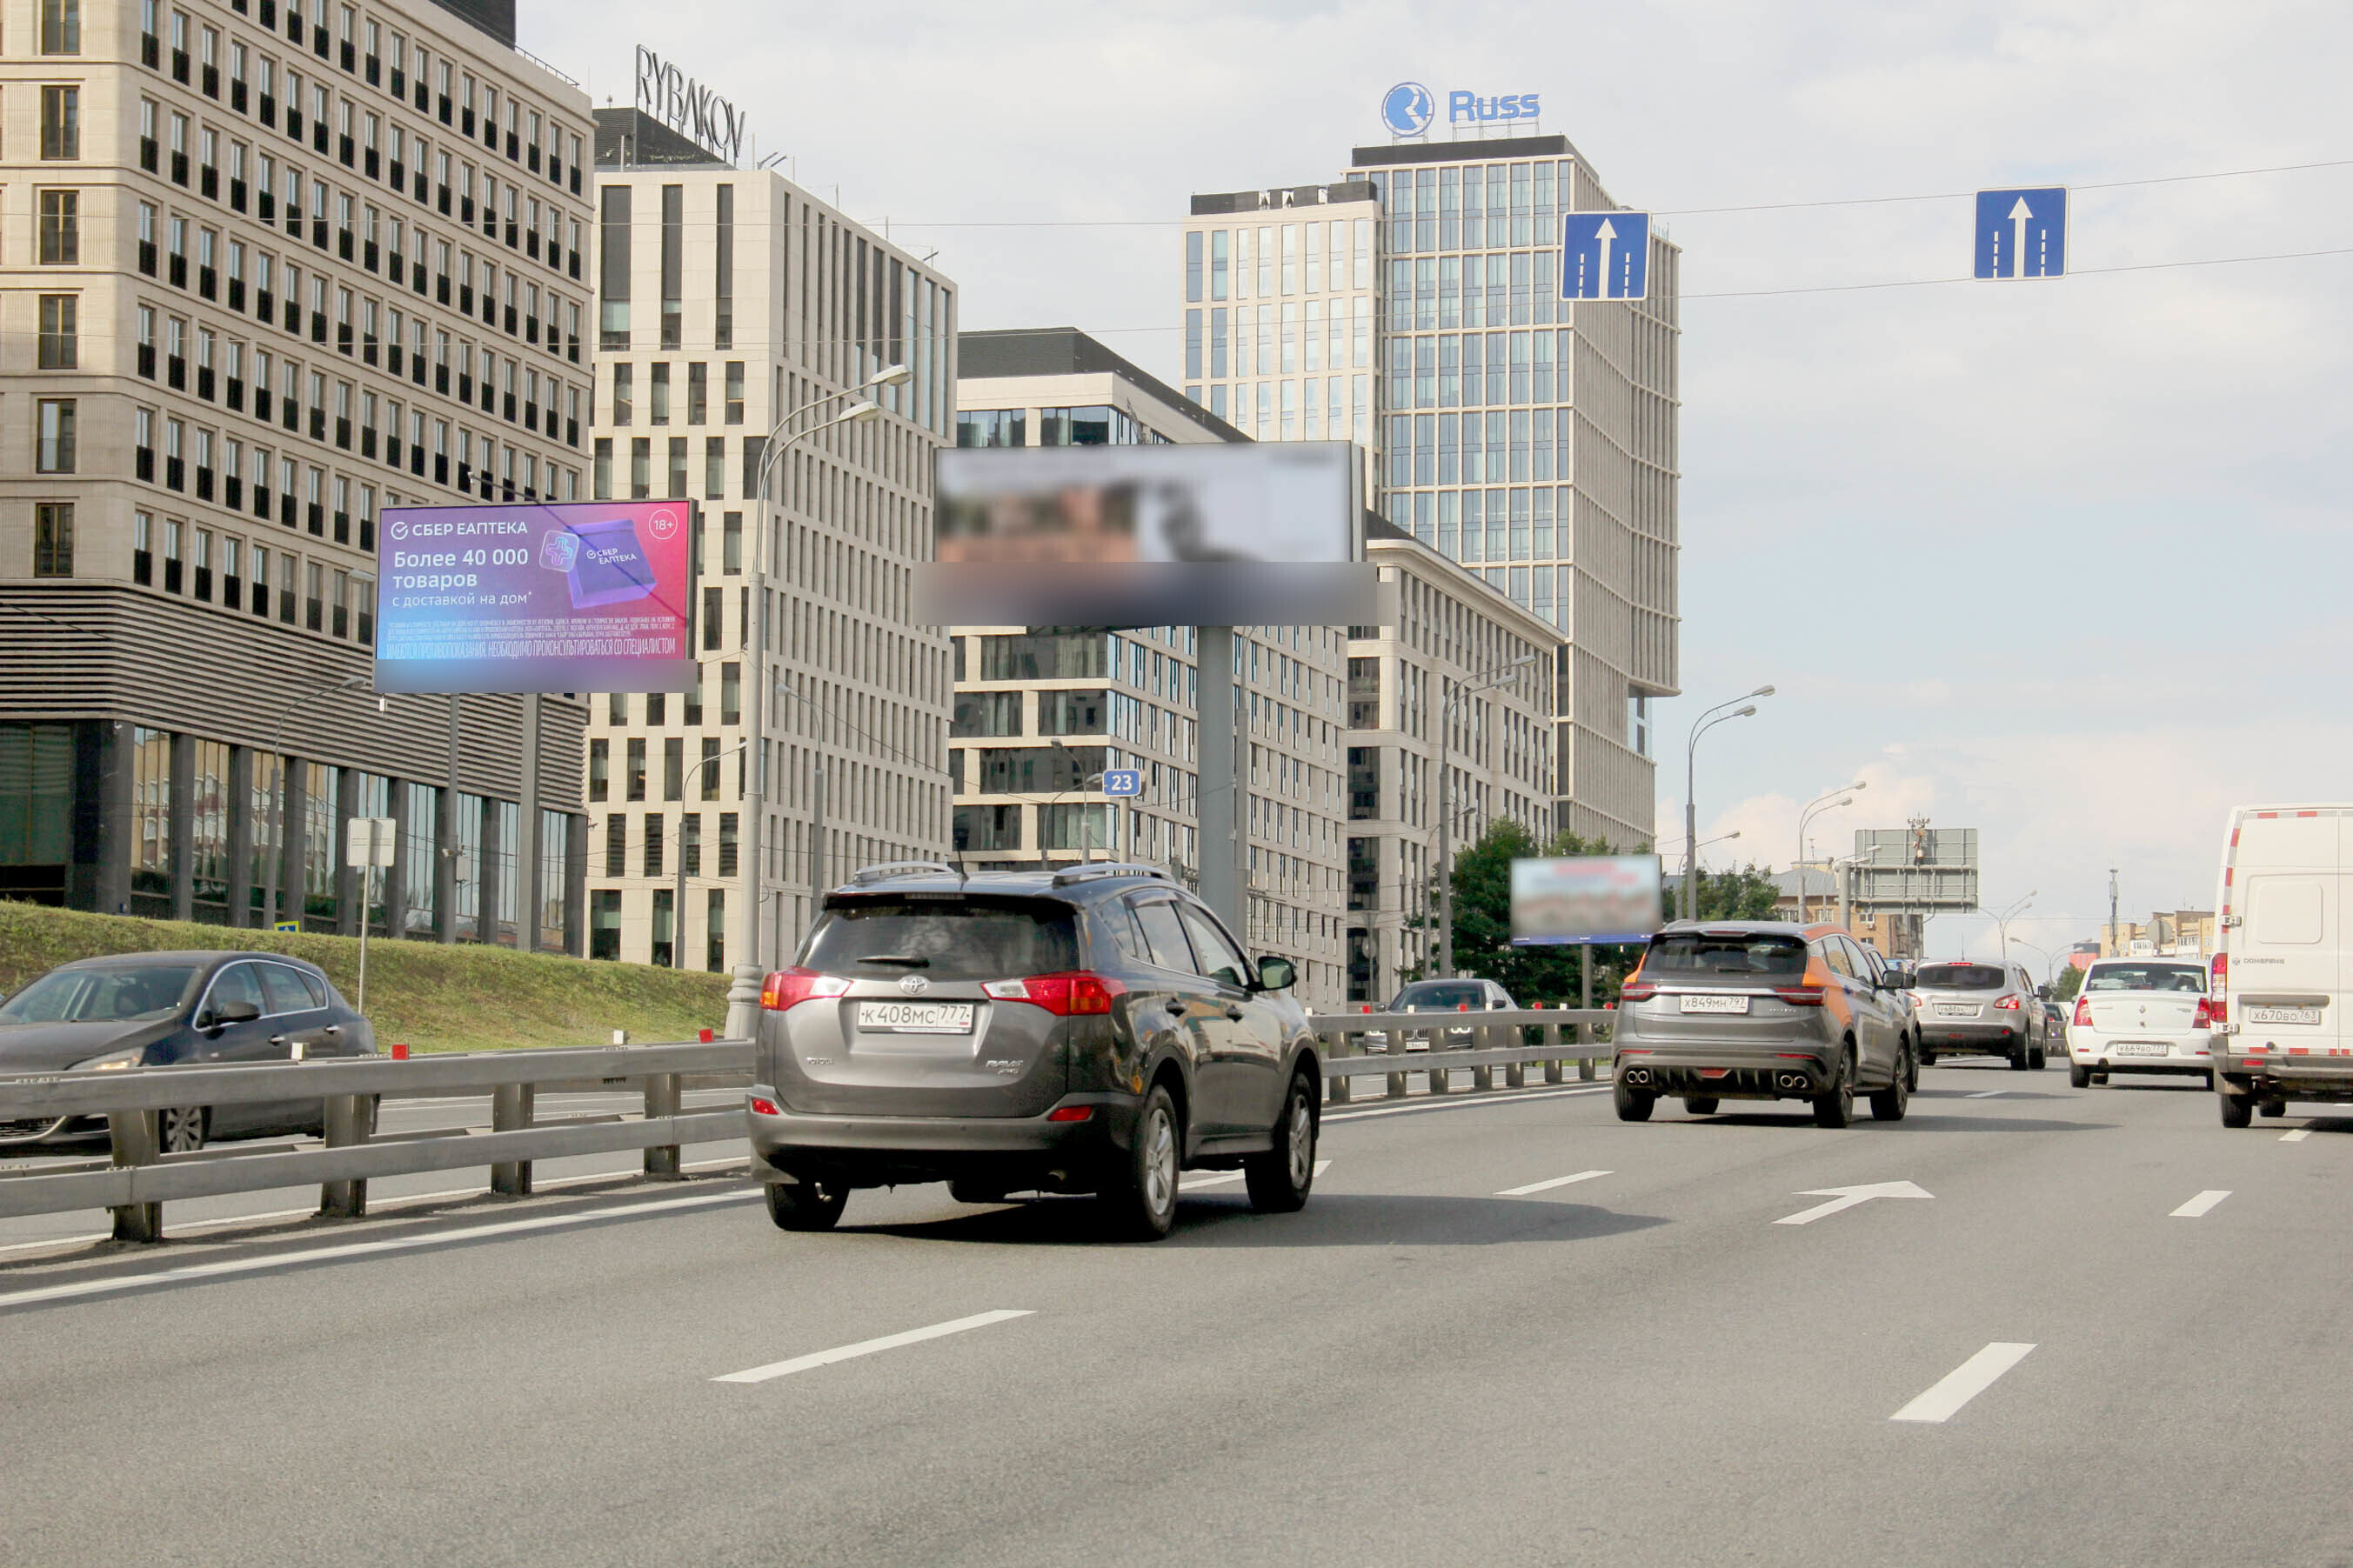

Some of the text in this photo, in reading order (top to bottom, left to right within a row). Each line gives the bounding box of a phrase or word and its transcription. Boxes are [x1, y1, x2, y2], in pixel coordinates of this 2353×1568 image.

[1449, 90, 1541, 123] Russ
[412, 521, 528, 537] СБЕР ЕАПТЕКА
[653, 519, 674, 530] 18+
[394, 548, 529, 568] Более 40 000
[597, 548, 618, 557] СБЕР
[598, 554, 637, 564] ЕАПТЕКА
[392, 573, 478, 591] товаров
[392, 597, 400, 606] с
[403, 592, 476, 608] доставкой
[479, 594, 496, 605] на
[1112, 774, 1133, 791] 23
[1684, 998, 1727, 1008] Х849МН
[864, 1005, 967, 1024] К408МС 777
